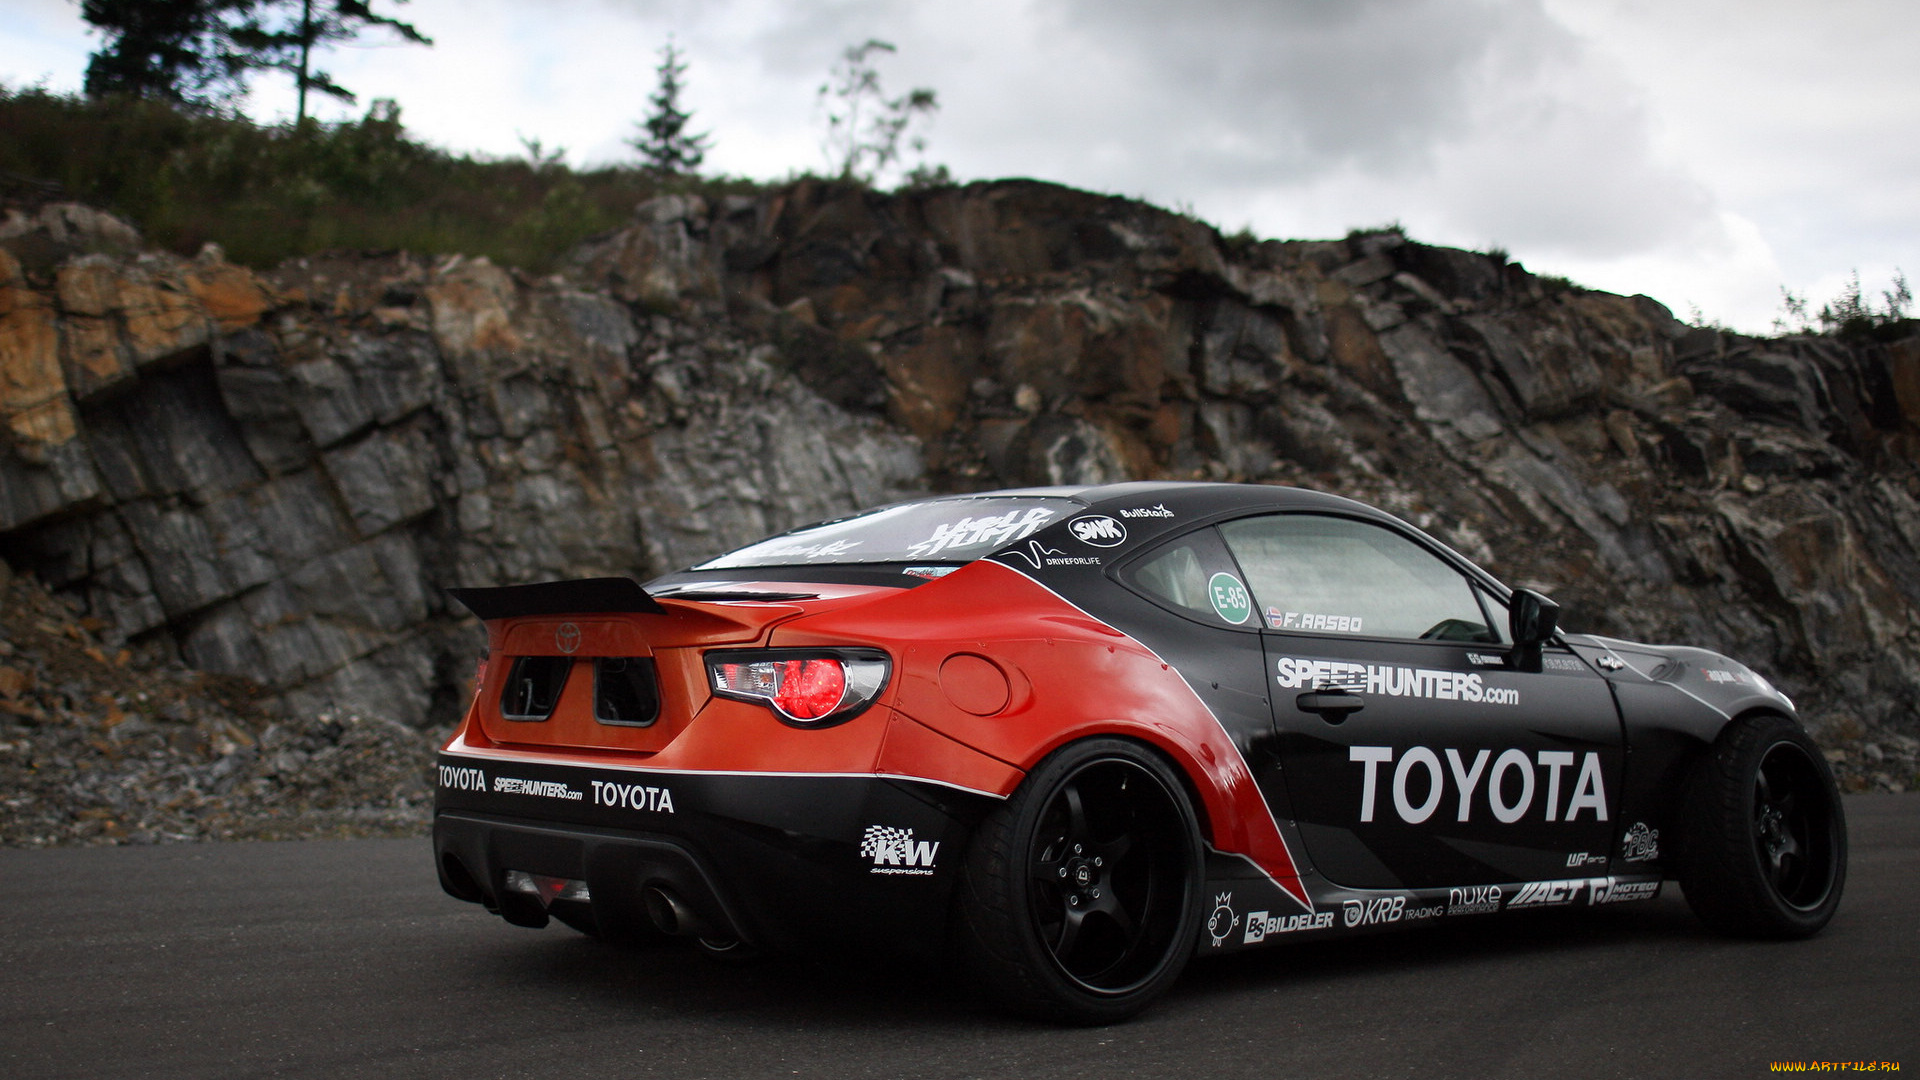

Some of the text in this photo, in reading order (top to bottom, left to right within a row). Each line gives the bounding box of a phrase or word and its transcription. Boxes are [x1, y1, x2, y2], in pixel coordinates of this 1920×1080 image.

[1046, 557, 1101, 566] DRIVEFORLIFE
[1214, 586, 1247, 609] E-85
[1277, 657, 1519, 705] SPEEDHUNTERS.com
[439, 765, 486, 792] TOYOTA
[493, 776, 583, 801] SPEEDHUNTERS.com
[1349, 745, 1609, 824] TOYOTA
[591, 780, 675, 814] TOYOTA
[873, 839, 940, 867] KW
[870, 867, 934, 876] suspensions
[1449, 885, 1502, 906] nuke
[1612, 881, 1659, 893] MOTEGI
[1265, 912, 1334, 934] BILDELER
[1362, 896, 1443, 925] KRB TRADING
